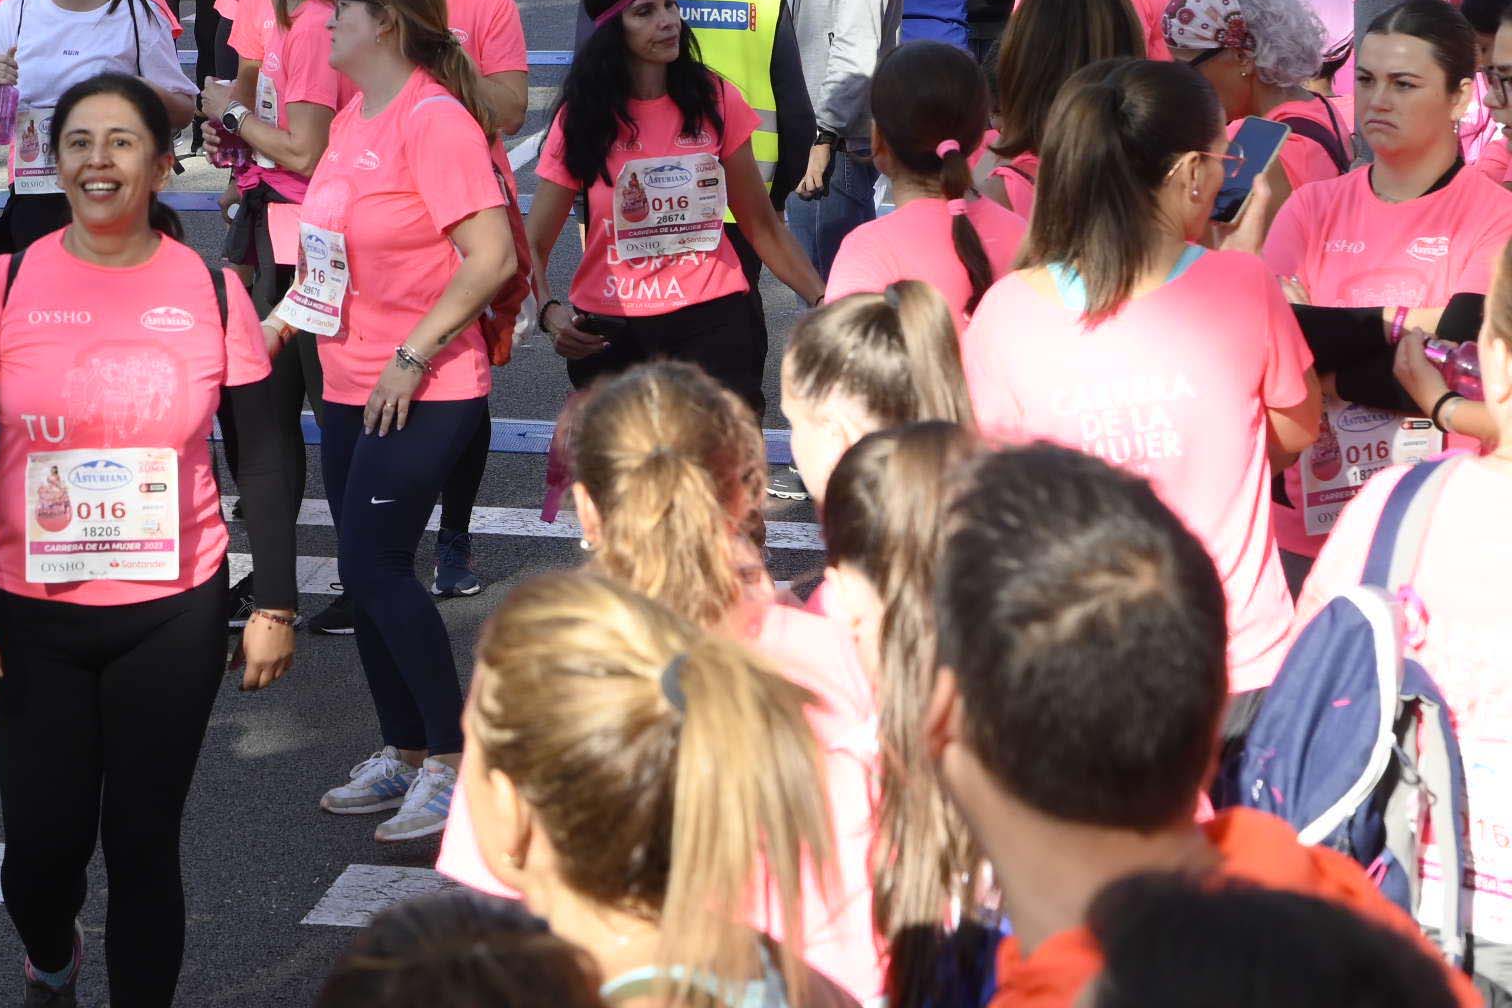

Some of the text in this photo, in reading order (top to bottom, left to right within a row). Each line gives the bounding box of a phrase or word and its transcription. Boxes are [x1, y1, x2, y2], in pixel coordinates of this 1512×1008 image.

[680, 7, 747, 23] UNTARIS
[649, 171, 690, 185] ASTURIANA
[651, 195, 689, 212] 016
[656, 213, 686, 225] 28674
[602, 274, 686, 300] SUMA
[28, 310, 92, 326] OYSHO
[20, 413, 66, 443] TU
[1079, 404, 1173, 441] DE LA
[1345, 440, 1390, 465] 016
[73, 471, 129, 484] ASTURIANA
[77, 501, 127, 520] 016
[82, 526, 121, 538] 18205
[44, 543, 84, 553] CARRERA
[86, 543, 98, 552] DE
[99, 543, 111, 552] LA
[112, 542, 141, 551] MUJER
[40, 558, 166, 573] OYSHO Santander
